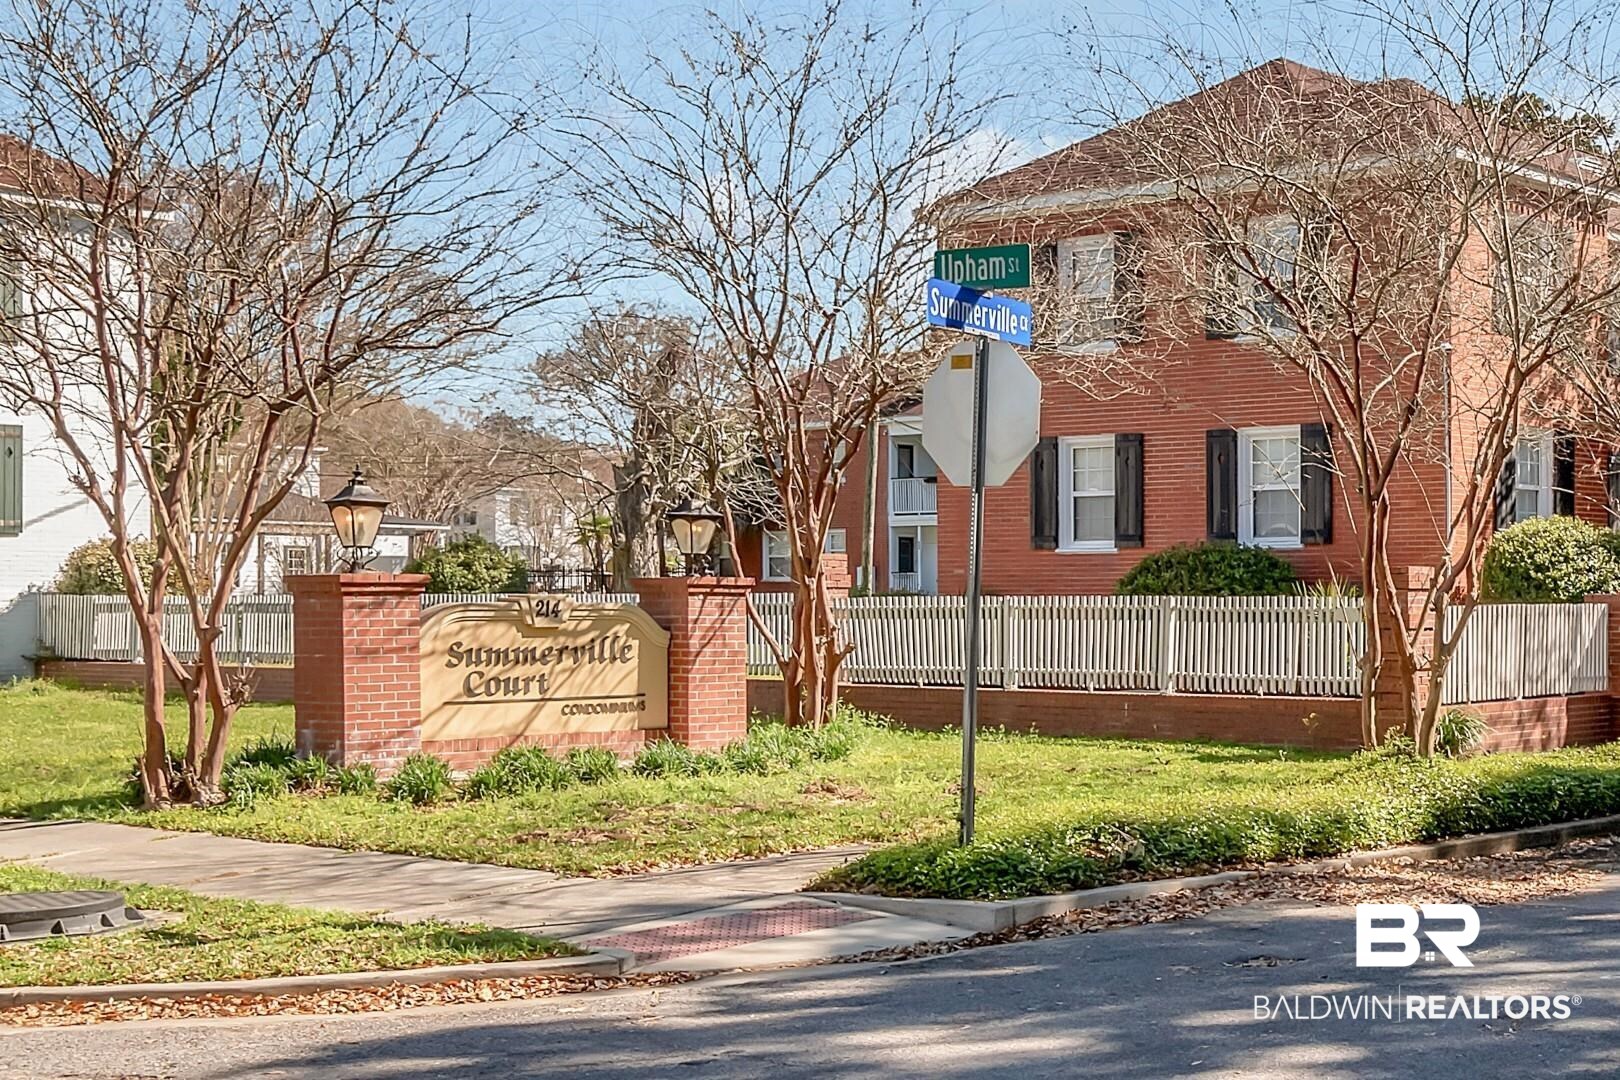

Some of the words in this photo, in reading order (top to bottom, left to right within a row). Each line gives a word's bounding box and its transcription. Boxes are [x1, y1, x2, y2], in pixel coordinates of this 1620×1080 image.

[941, 253, 1006, 284] Upham
[1008, 257, 1020, 273] St
[930, 287, 1018, 335] Summerville
[535, 600, 562, 619] 214
[445, 635, 634, 669] Summerville
[462, 670, 551, 698] Court
